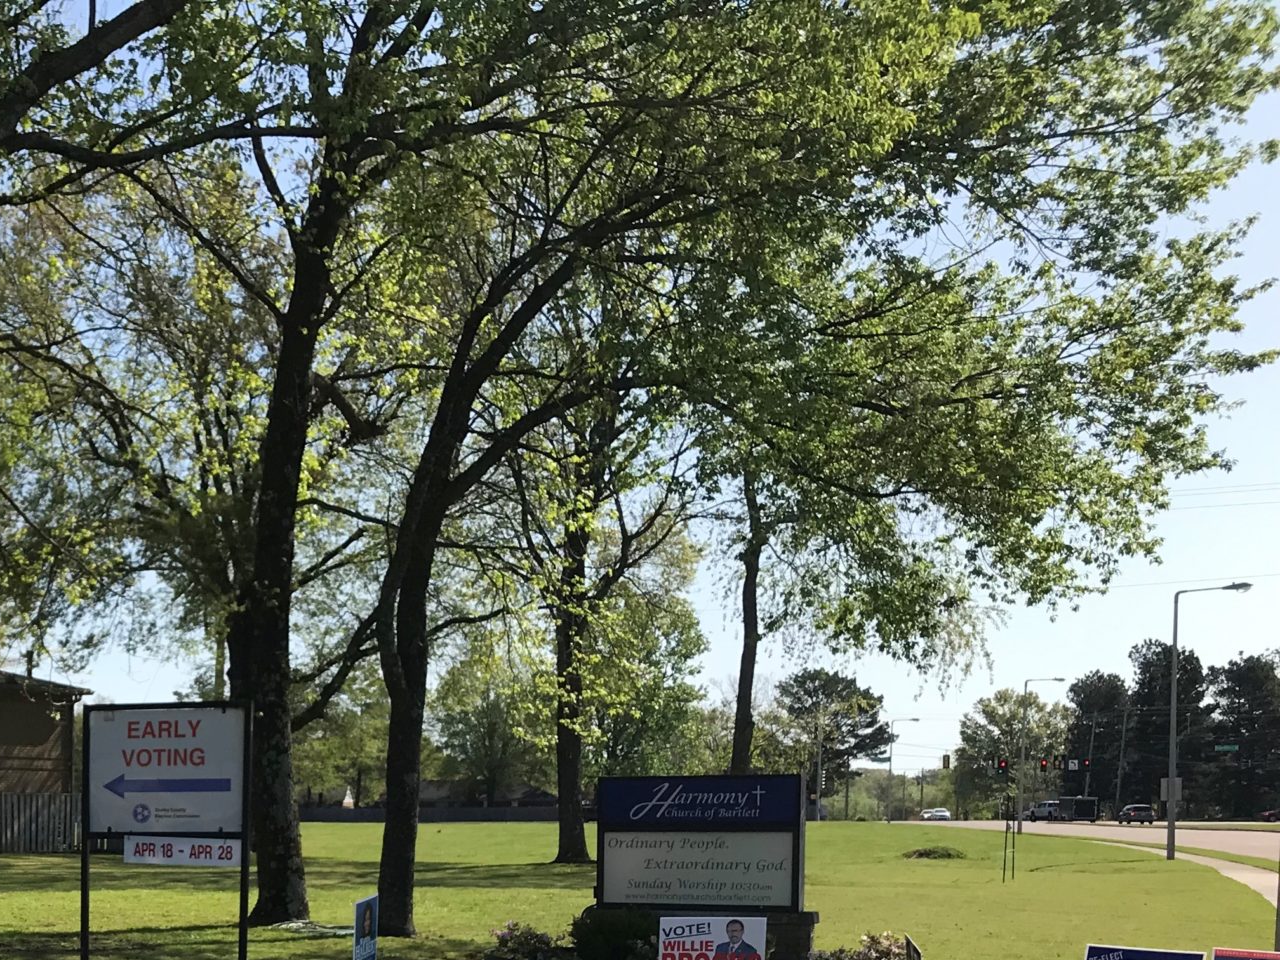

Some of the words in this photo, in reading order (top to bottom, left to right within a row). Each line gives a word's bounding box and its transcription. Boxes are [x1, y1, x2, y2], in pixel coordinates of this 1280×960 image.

[127, 720, 201, 739] EARLY
[122, 748, 205, 767] VOTING
[630, 782, 749, 820] Harmony
[664, 808, 702, 818] Church
[704, 807, 716, 820] of
[718, 807, 760, 818] Bartlett
[134, 842, 156, 857] APR
[161, 843, 173, 857] 18
[189, 844, 212, 860] APR
[218, 845, 233, 861] 28
[608, 837, 674, 852] Ordinary
[679, 836, 730, 852] People.
[644, 858, 751, 874] Extraordinary
[755, 858, 787, 871] God.
[627, 878, 672, 892] Sunday
[677, 878, 726, 893] Worship
[662, 922, 711, 937] VOTE!
[663, 940, 714, 952] WILLIE
